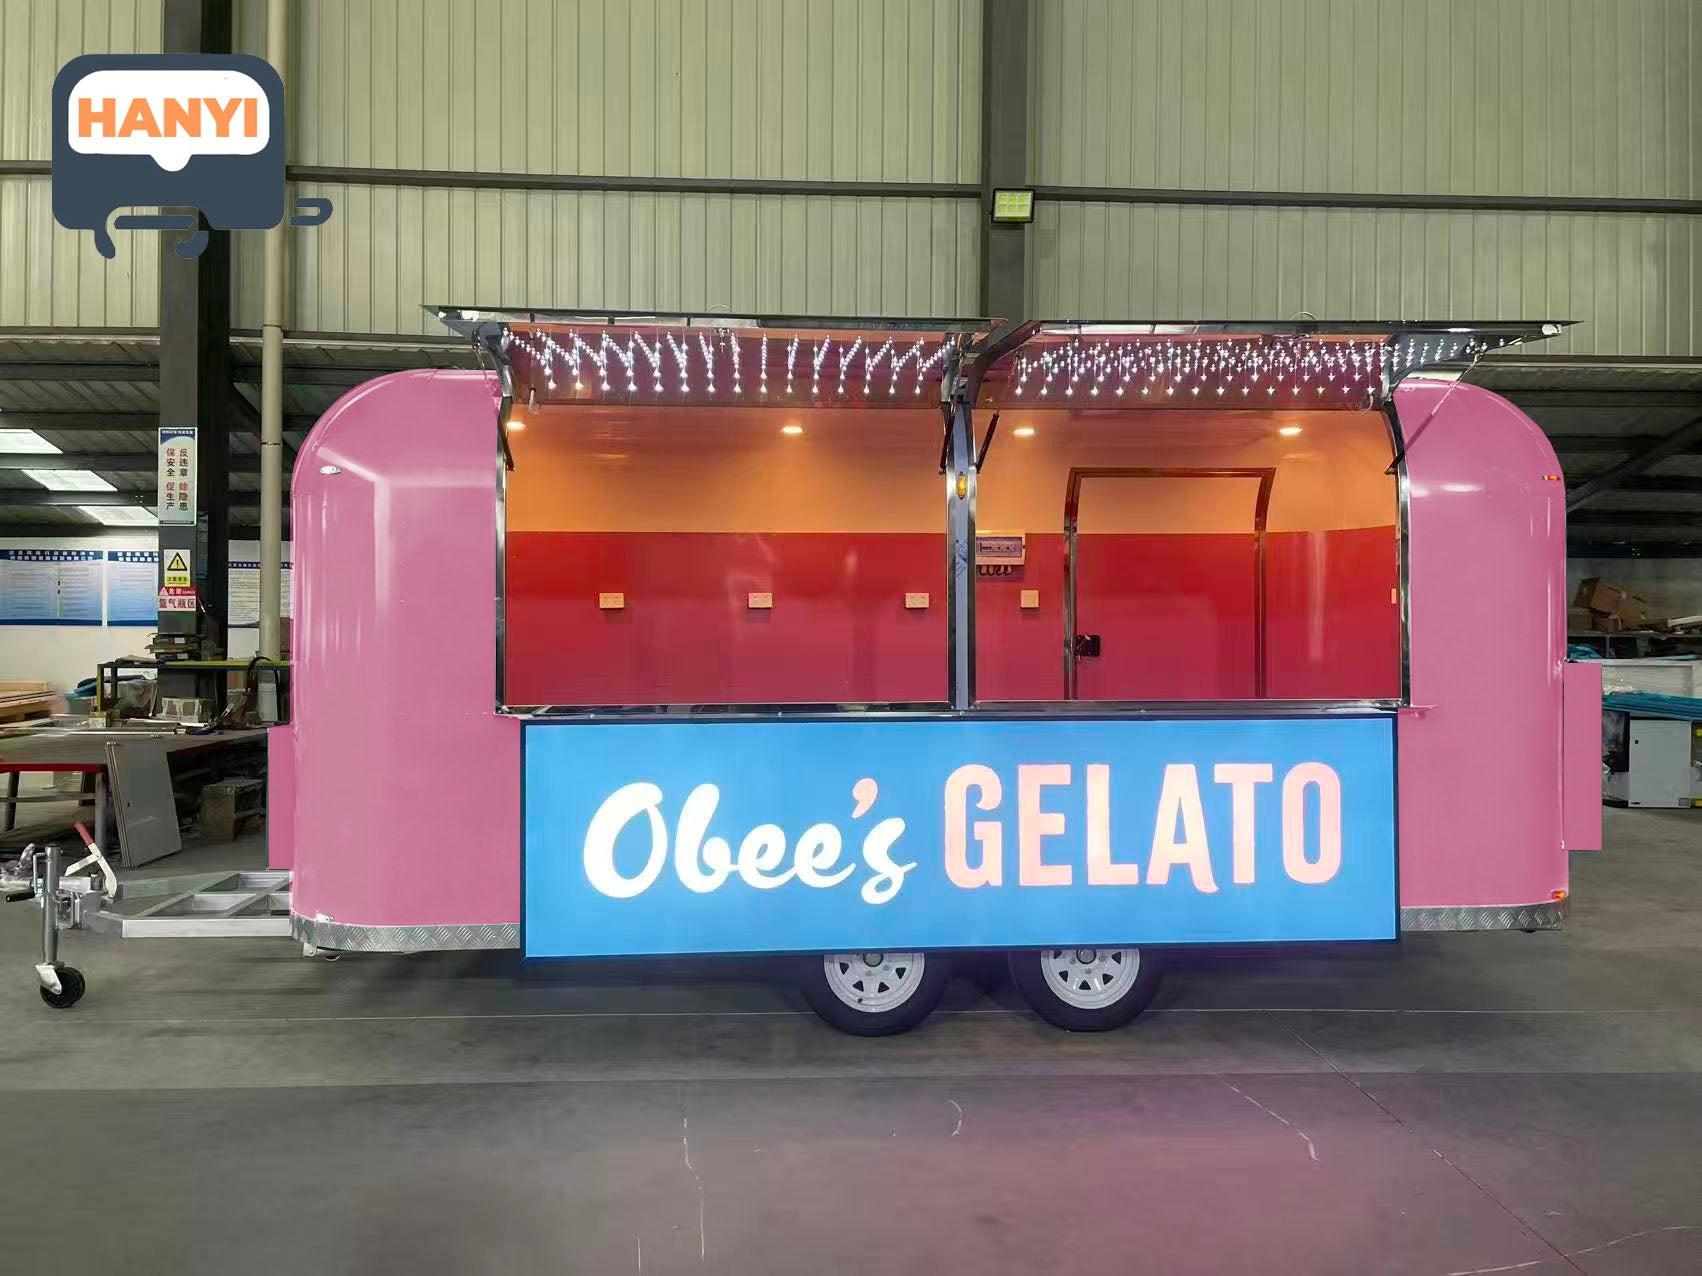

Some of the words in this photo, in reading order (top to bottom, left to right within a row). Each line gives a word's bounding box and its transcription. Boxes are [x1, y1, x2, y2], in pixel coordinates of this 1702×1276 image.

[166, 447, 176, 477] 保安全
[179, 448, 189, 477] 反违章
[166, 482, 176, 511] 促生产
[583, 777, 917, 904] Obee's
[944, 762, 1341, 893] GELATO
